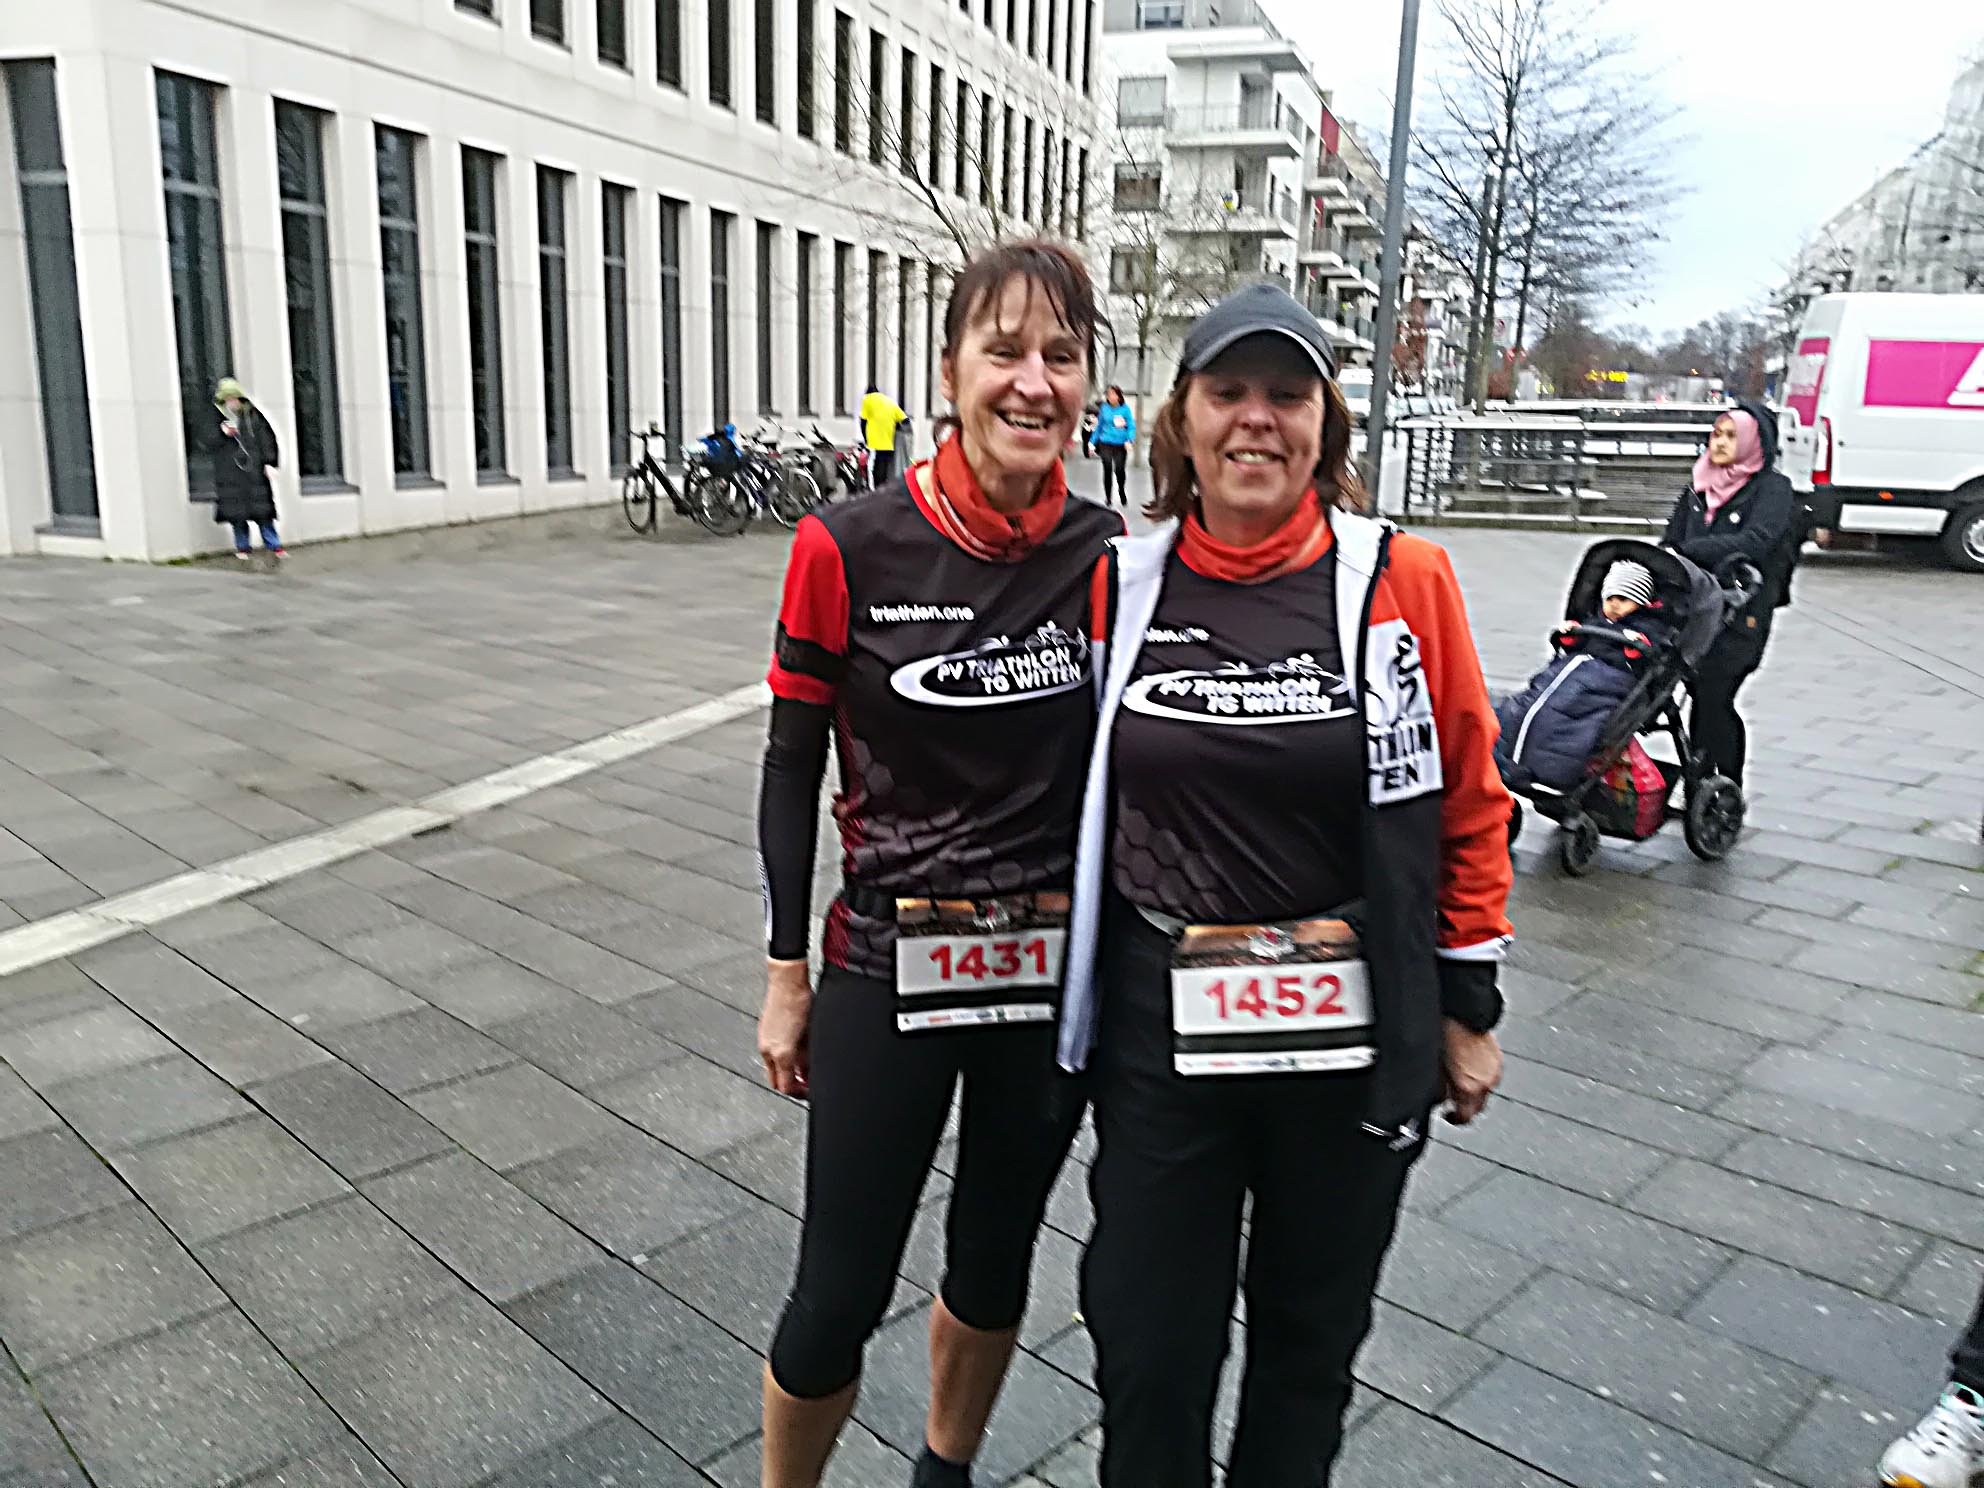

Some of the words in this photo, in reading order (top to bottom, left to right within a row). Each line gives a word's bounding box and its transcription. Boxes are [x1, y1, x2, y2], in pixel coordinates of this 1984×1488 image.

[966, 646, 1070, 680] TRIATHLON
[1010, 663, 1082, 690] WITTEN
[929, 938, 1049, 981] 1431
[1204, 974, 1345, 1019] 1452
